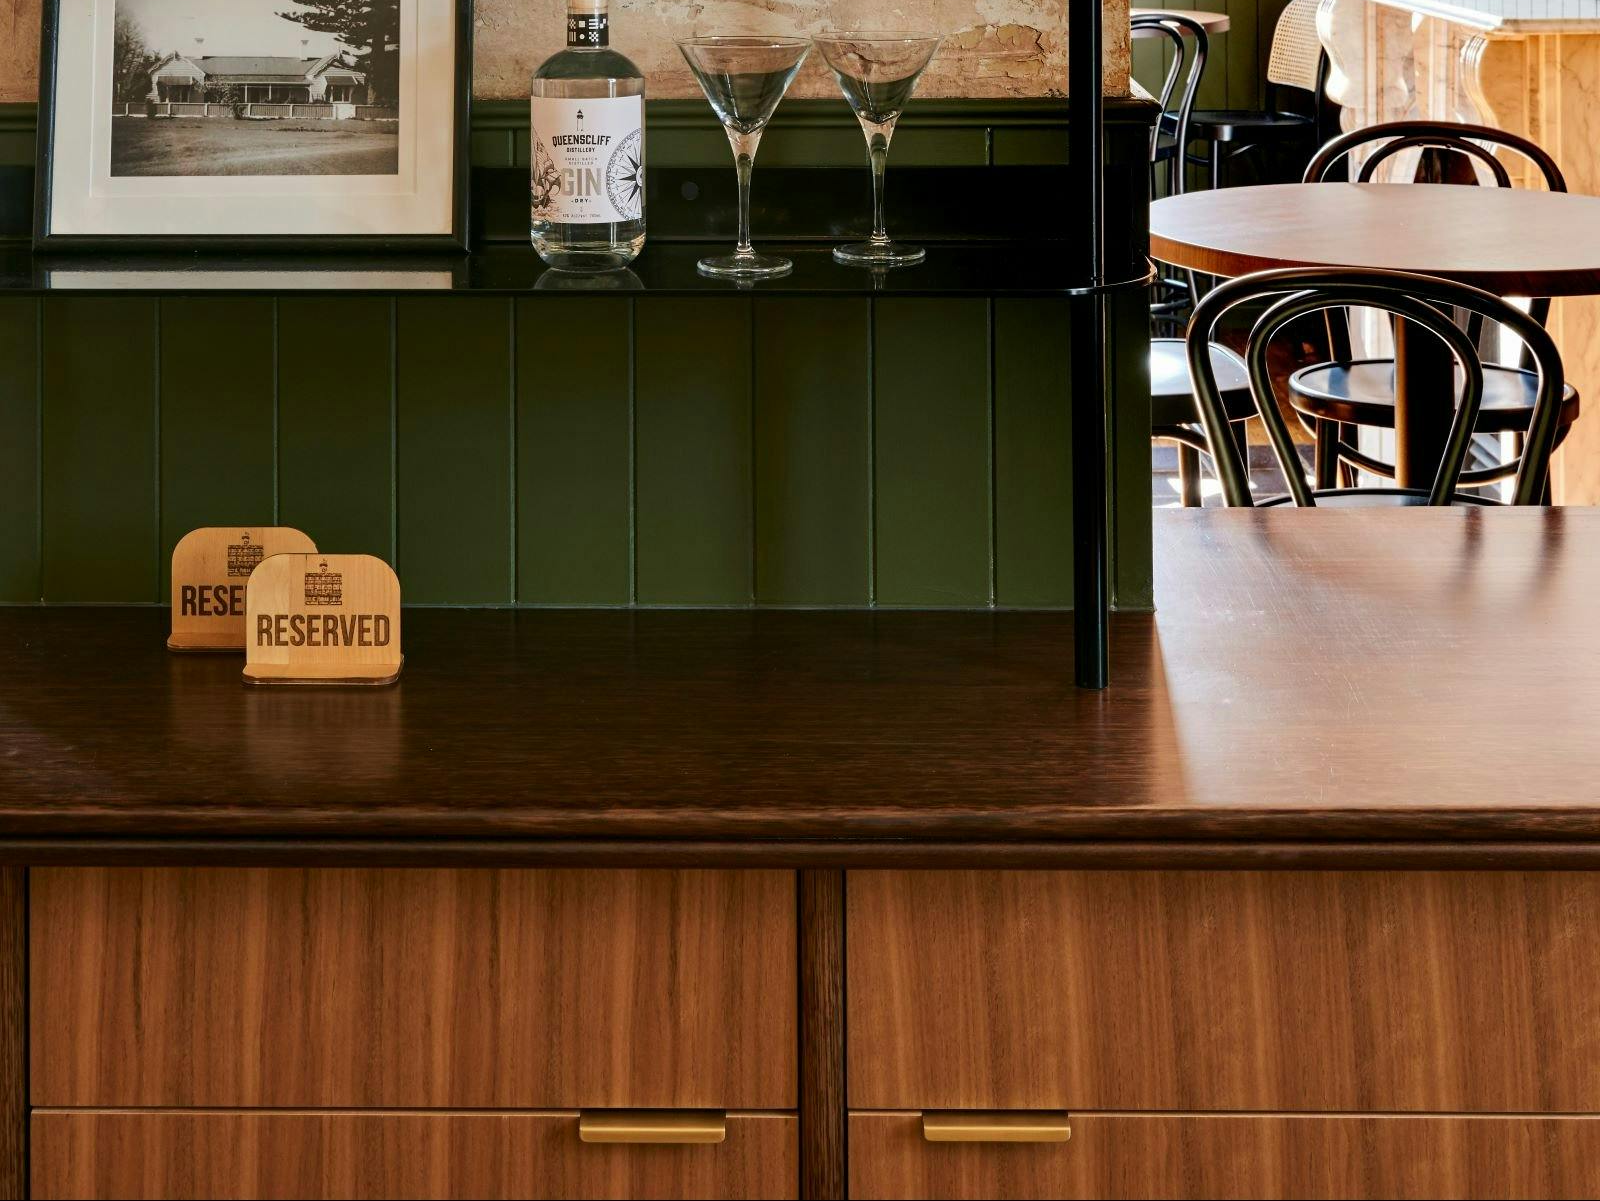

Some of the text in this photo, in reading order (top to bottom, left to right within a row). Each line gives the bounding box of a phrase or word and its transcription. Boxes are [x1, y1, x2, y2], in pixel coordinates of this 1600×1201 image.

[552, 134, 612, 147] QUEENSCLIFF
[561, 168, 602, 197] GIN
[181, 585, 247, 617] RESE
[257, 614, 390, 647] RESERVED
